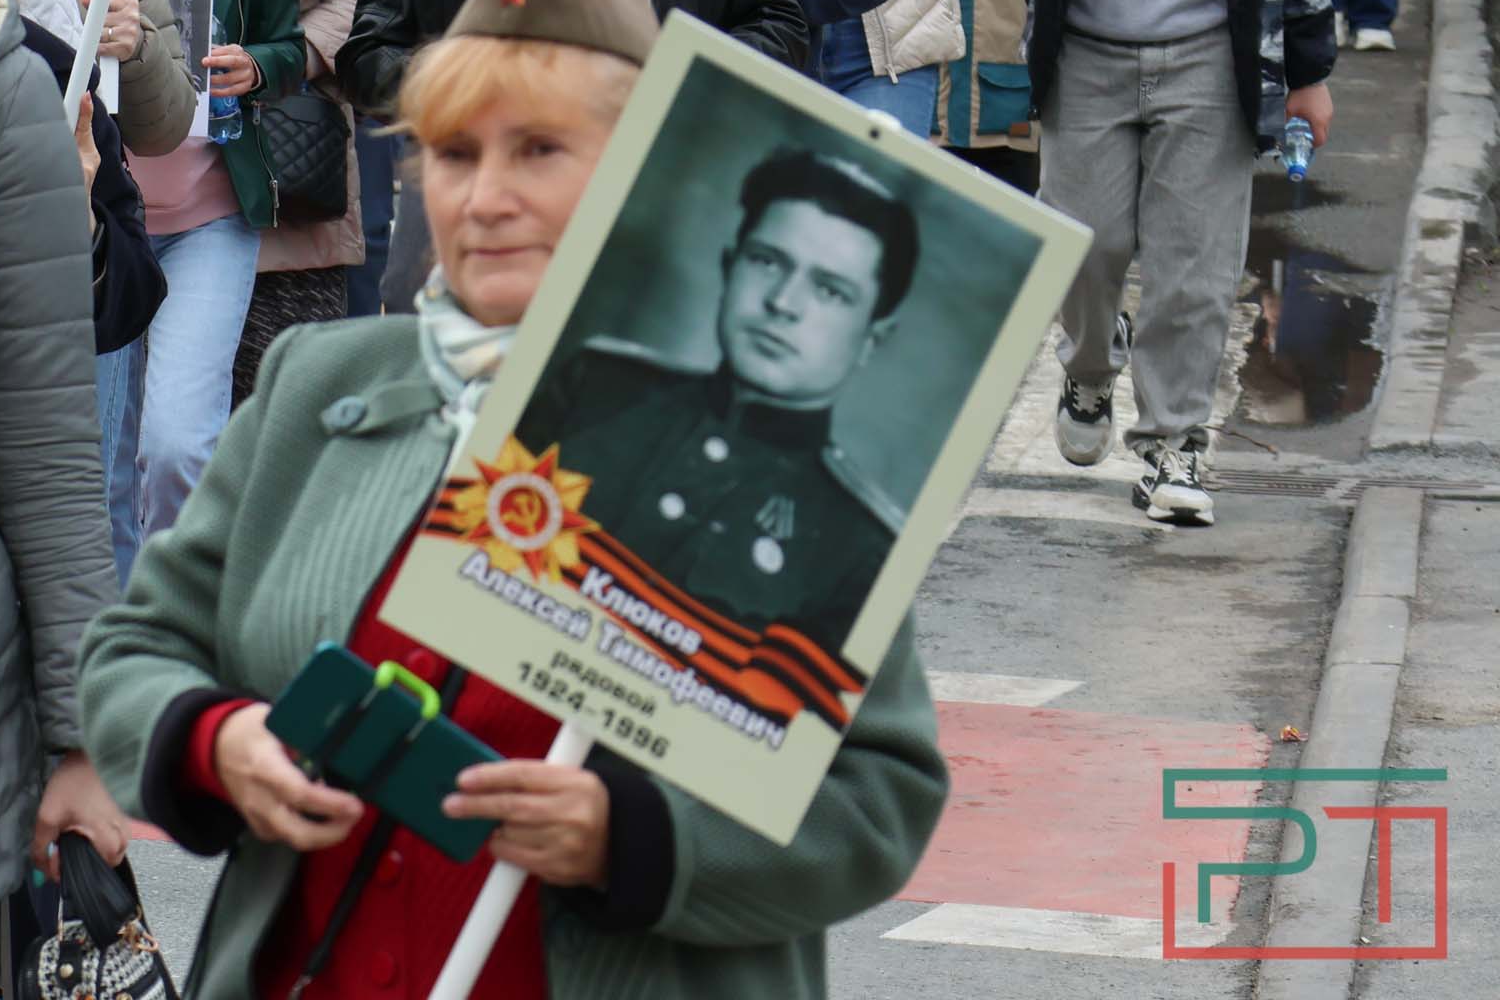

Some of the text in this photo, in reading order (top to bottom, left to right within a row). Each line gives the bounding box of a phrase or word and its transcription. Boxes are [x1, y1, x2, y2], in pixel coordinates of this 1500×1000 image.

[460, 550, 787, 752] Алексей Тимофеевич
[580, 565, 702, 656] Клюков
[550, 651, 657, 718] рядовой
